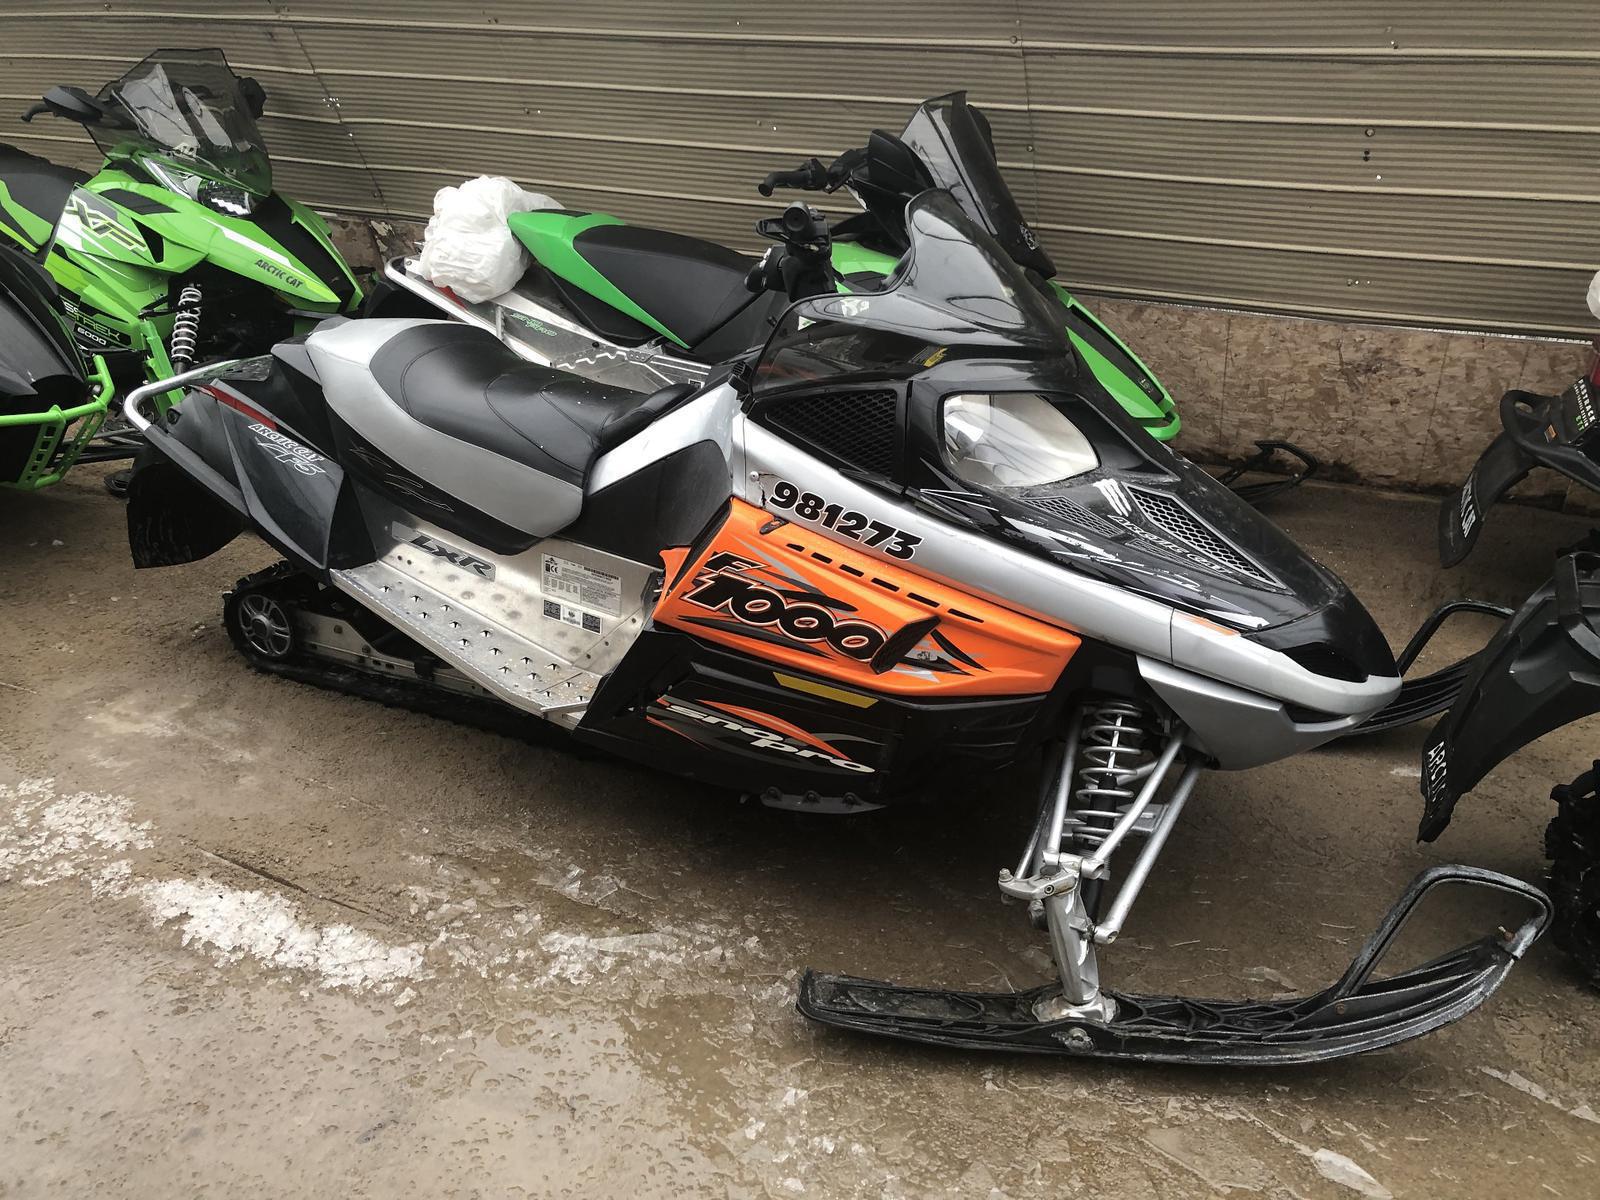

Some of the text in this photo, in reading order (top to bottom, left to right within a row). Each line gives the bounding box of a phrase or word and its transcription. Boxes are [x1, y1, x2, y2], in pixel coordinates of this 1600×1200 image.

[254, 259, 303, 288] ARCTIC CAT
[248, 423, 326, 462] ARCTIC CAT
[766, 481, 924, 560] 981273
[1107, 515, 1189, 553] ARCTIC
[409, 535, 492, 577] LXR
